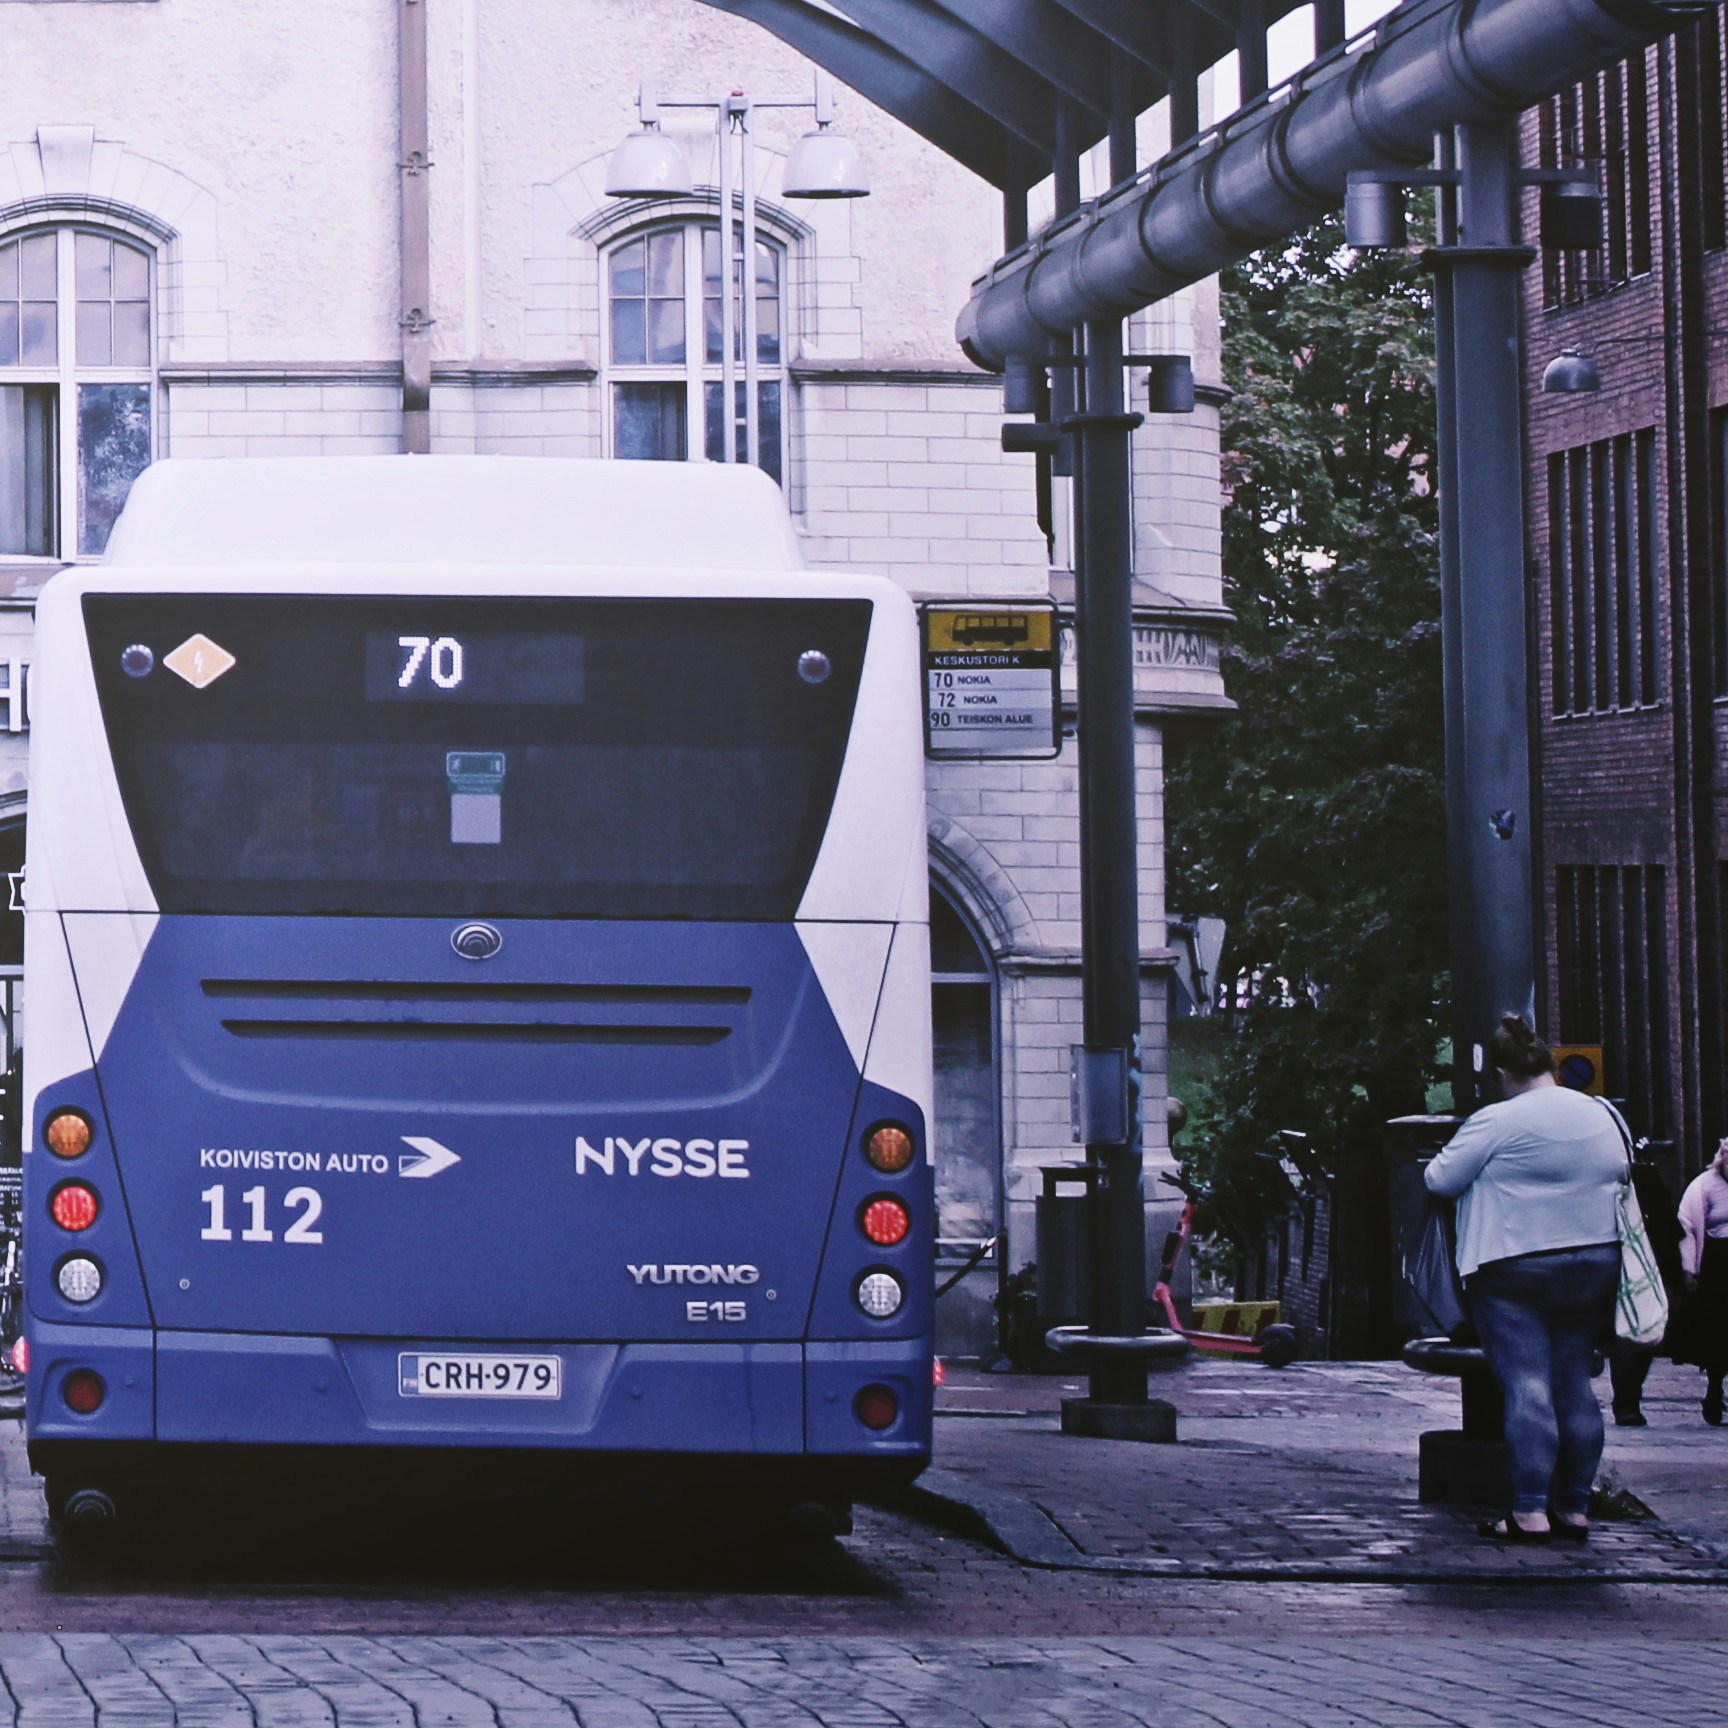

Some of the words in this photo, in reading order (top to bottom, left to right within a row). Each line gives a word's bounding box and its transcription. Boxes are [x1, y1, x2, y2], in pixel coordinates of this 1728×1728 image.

[398, 636, 463, 689] 70
[934, 656, 1009, 665] KESKUSTORI
[1012, 656, 1021, 664] K
[934, 672, 953, 688] 70
[957, 675, 991, 685] NOKIA
[938, 692, 956, 708] 72
[963, 695, 998, 704] NOKIA
[930, 712, 951, 727] 90
[957, 714, 1002, 724] TEISKON
[1005, 714, 1034, 724] ALUE
[199, 1148, 321, 1172] KOIVISTON
[325, 1152, 390, 1174] AUTO
[574, 1135, 751, 1178] NYSSE
[200, 1183, 324, 1244] 112
[626, 1263, 761, 1285] YUTONG
[685, 1300, 747, 1322] E15
[424, 1361, 552, 1391] CRH-979
